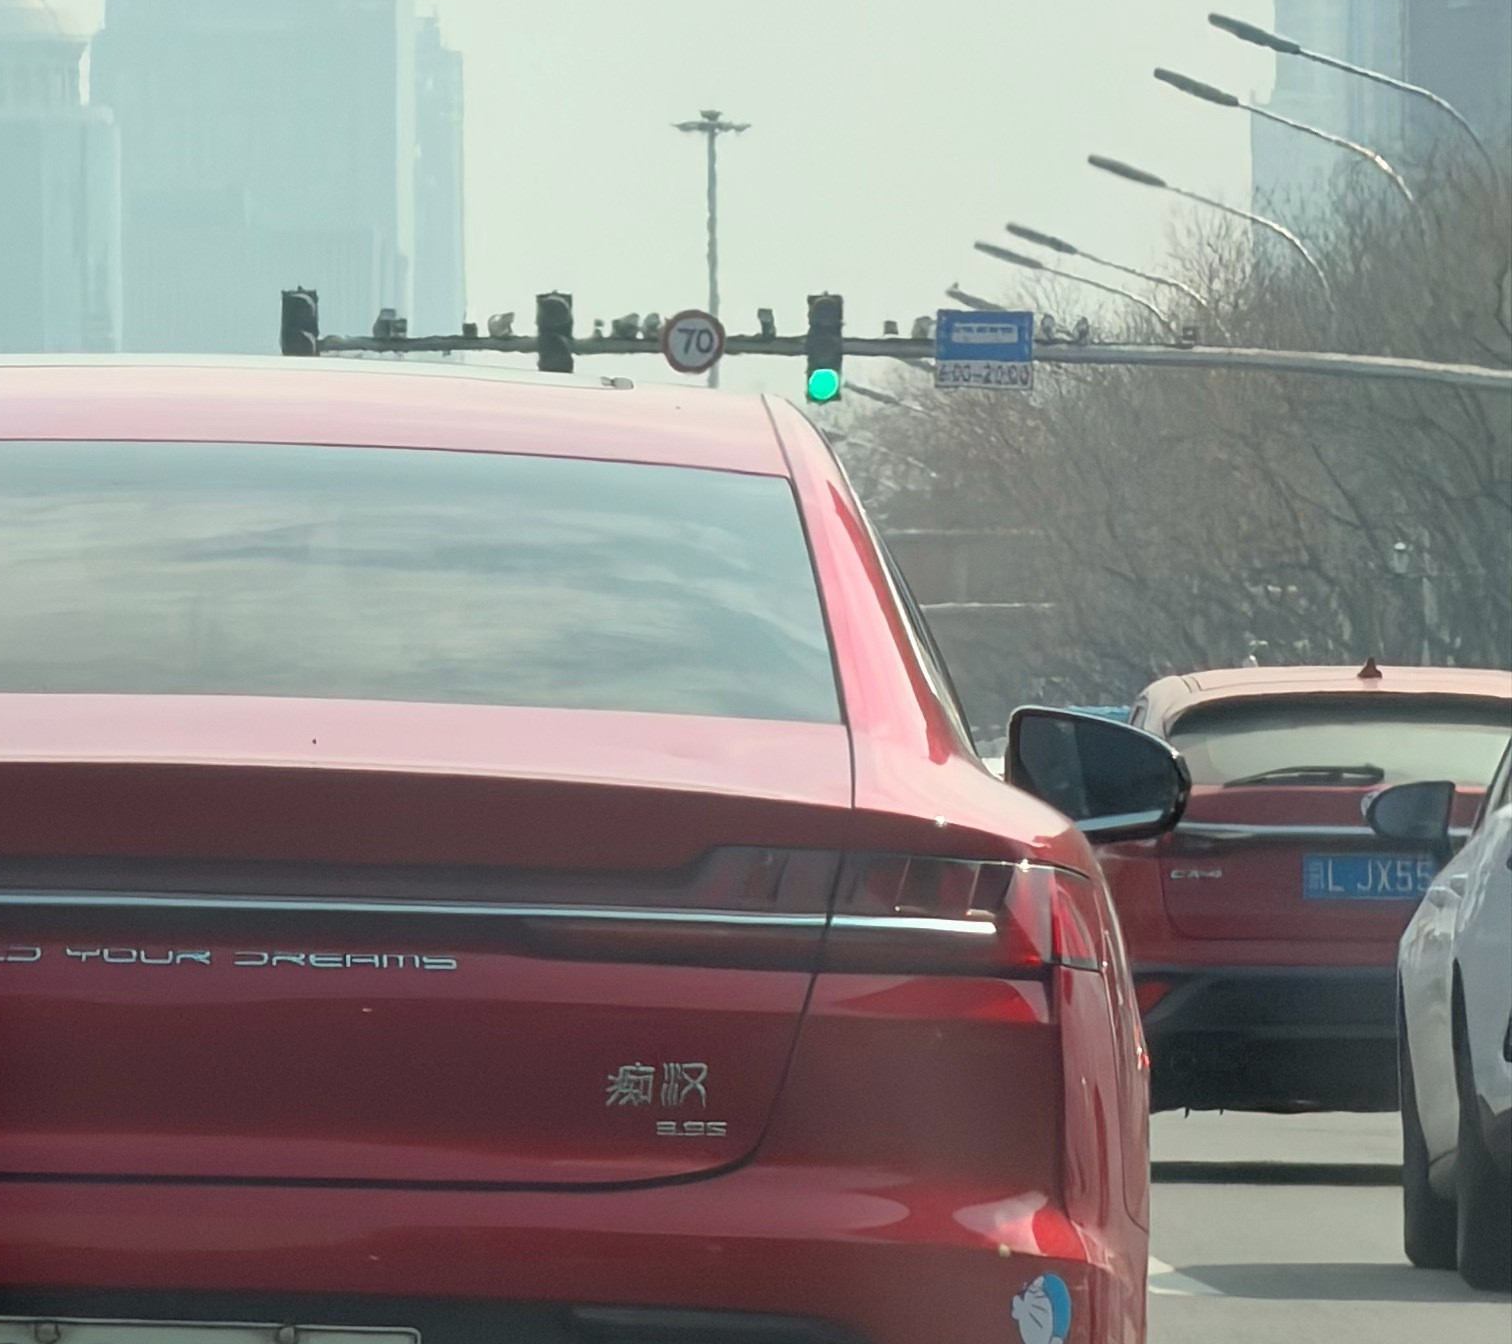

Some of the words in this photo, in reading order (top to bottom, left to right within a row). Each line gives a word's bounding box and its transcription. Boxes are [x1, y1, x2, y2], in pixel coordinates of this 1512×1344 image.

[677, 327, 714, 355] 70
[65, 947, 211, 965] YOUR
[234, 951, 458, 970] DREAMS
[605, 1061, 708, 1108] 痴汉
